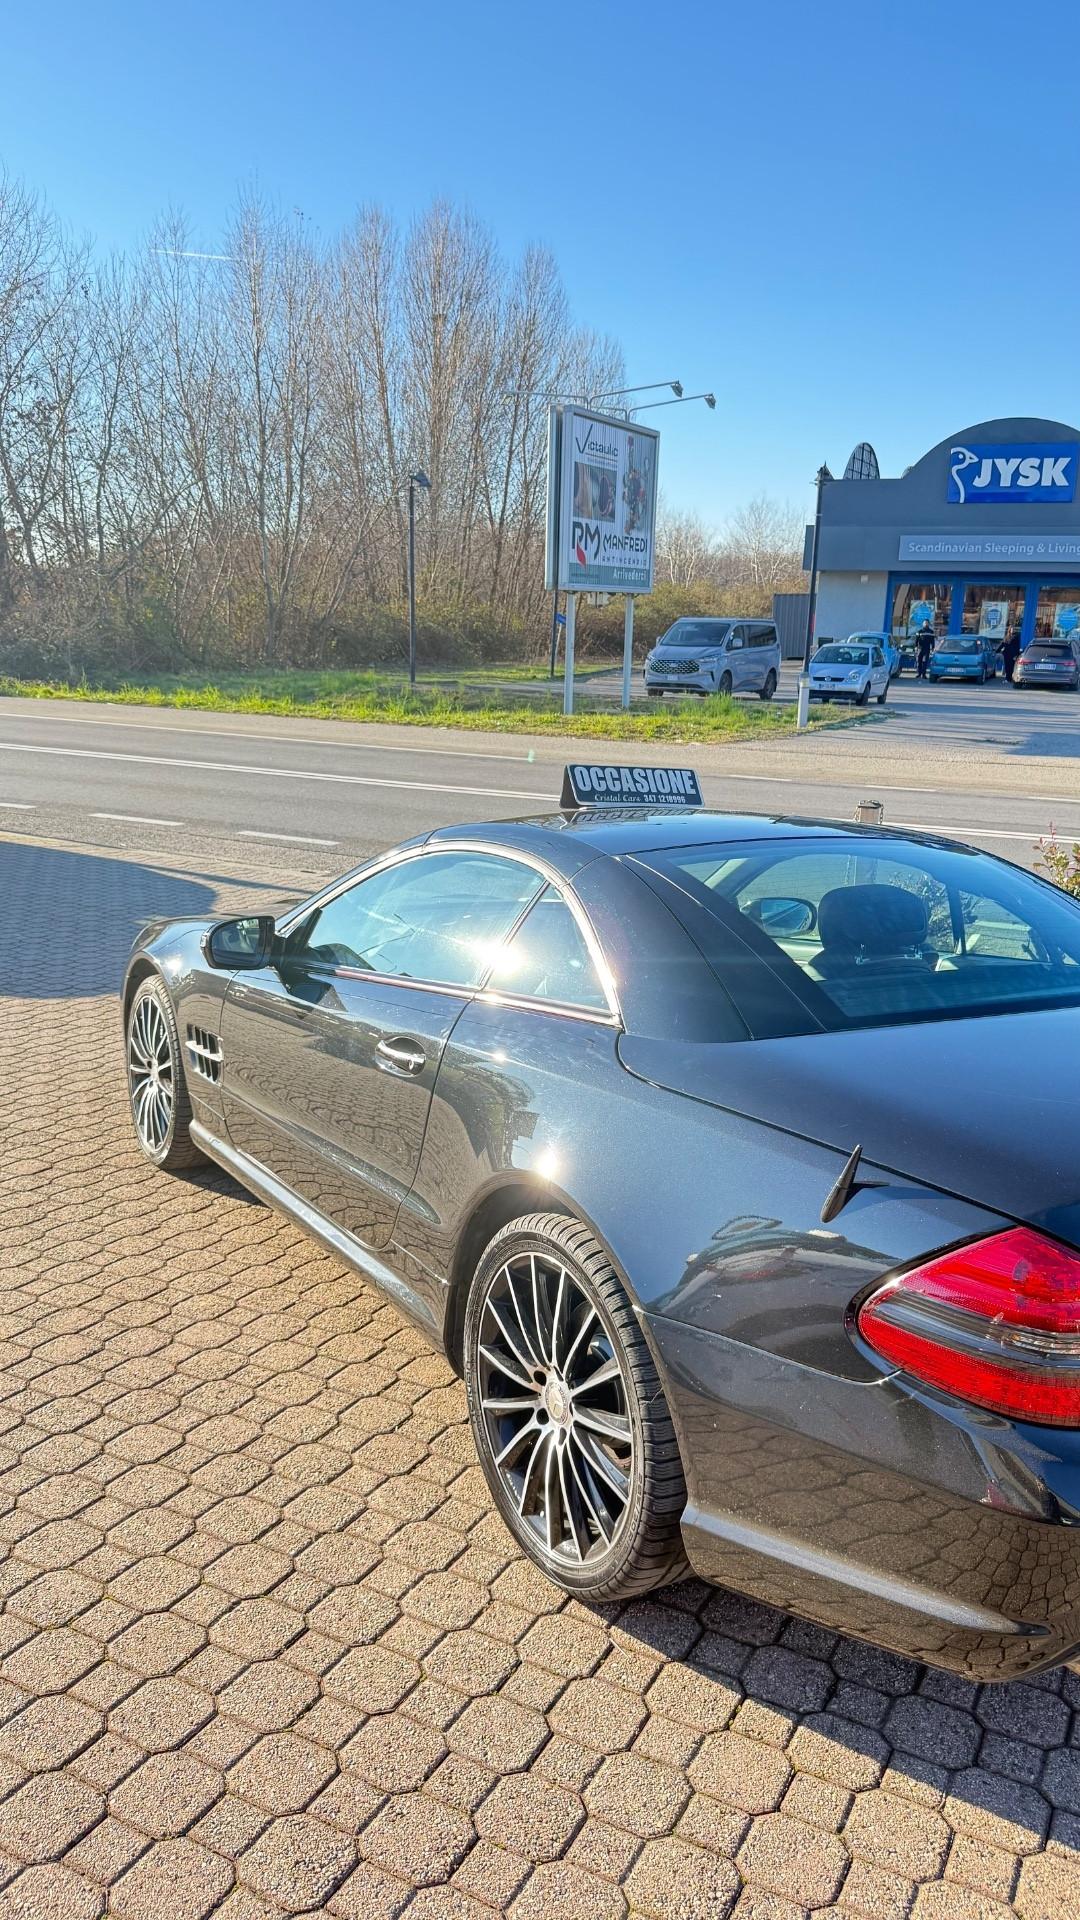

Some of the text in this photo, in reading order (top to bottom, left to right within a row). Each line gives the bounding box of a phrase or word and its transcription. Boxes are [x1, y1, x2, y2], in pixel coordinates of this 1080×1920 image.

[575, 423, 619, 457] Victaulic
[972, 457, 1072, 488] JYSK
[603, 534, 647, 553] MANFREDI
[908, 541, 982, 553] Scandinavian
[985, 542, 1034, 556] Sleeping
[1036, 543, 1046, 553] &
[573, 766, 697, 795] OCCASIONE
[594, 793, 621, 802] Cristal
[623, 794, 641, 802] Cars
[643, 794, 657, 803] 347
